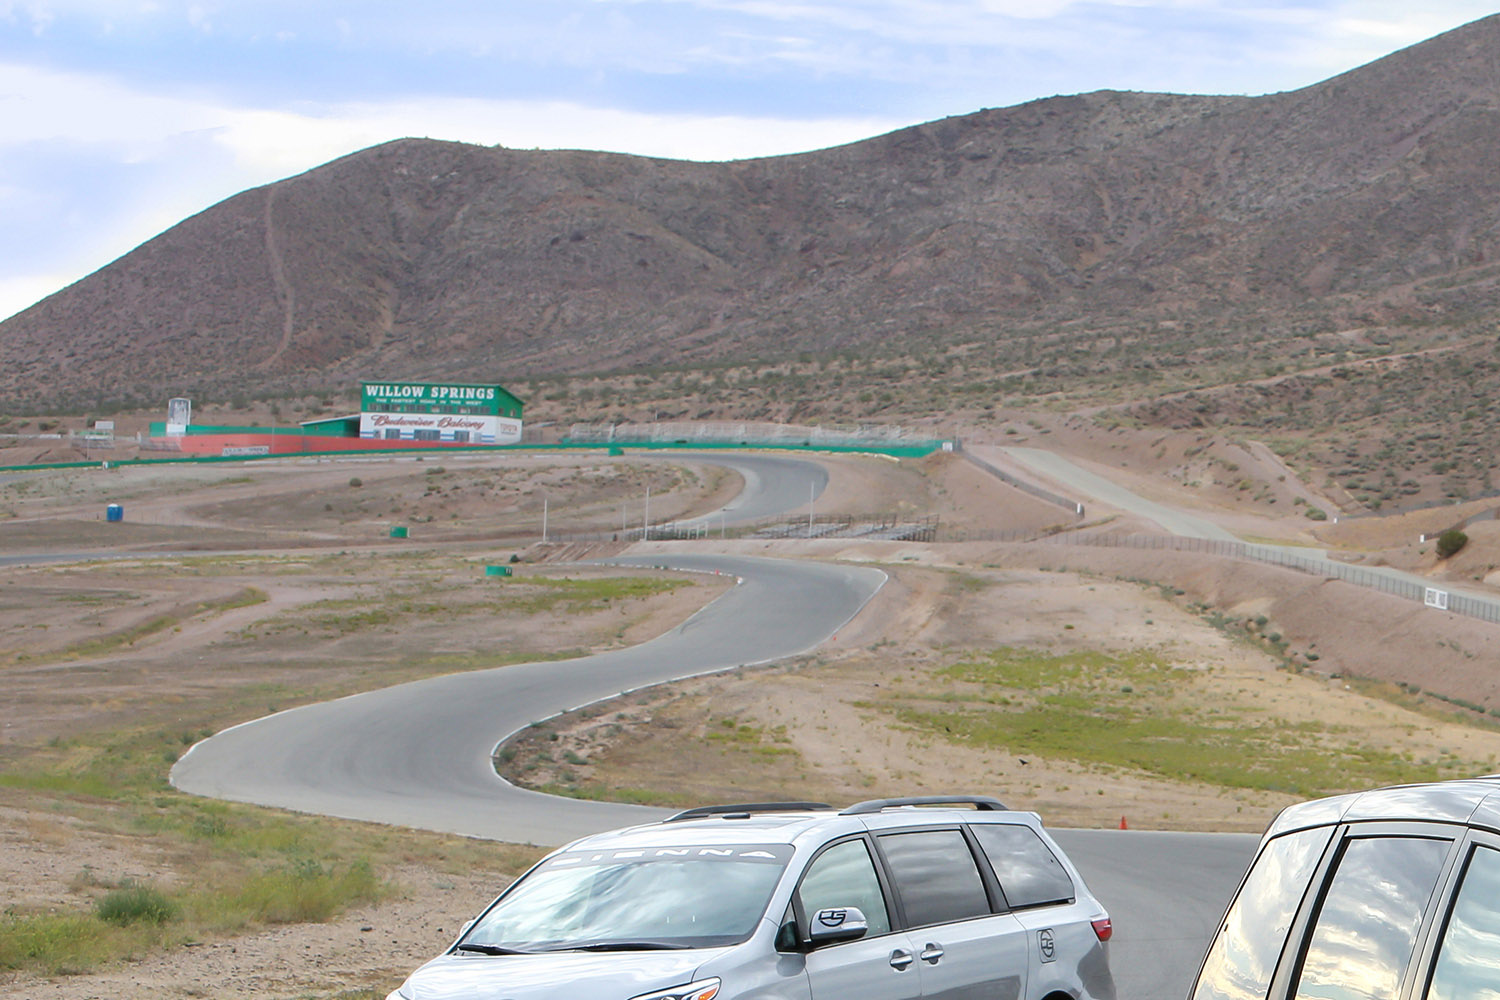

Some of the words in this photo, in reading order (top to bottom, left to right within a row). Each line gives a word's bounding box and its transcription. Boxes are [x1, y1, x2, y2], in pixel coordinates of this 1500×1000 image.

[366, 385, 424, 397] WILLOW
[431, 387, 495, 399] SPRINGS
[371, 415, 435, 427] Budweiser
[437, 416, 485, 429] Balcony
[551, 849, 776, 866] SIENNA
